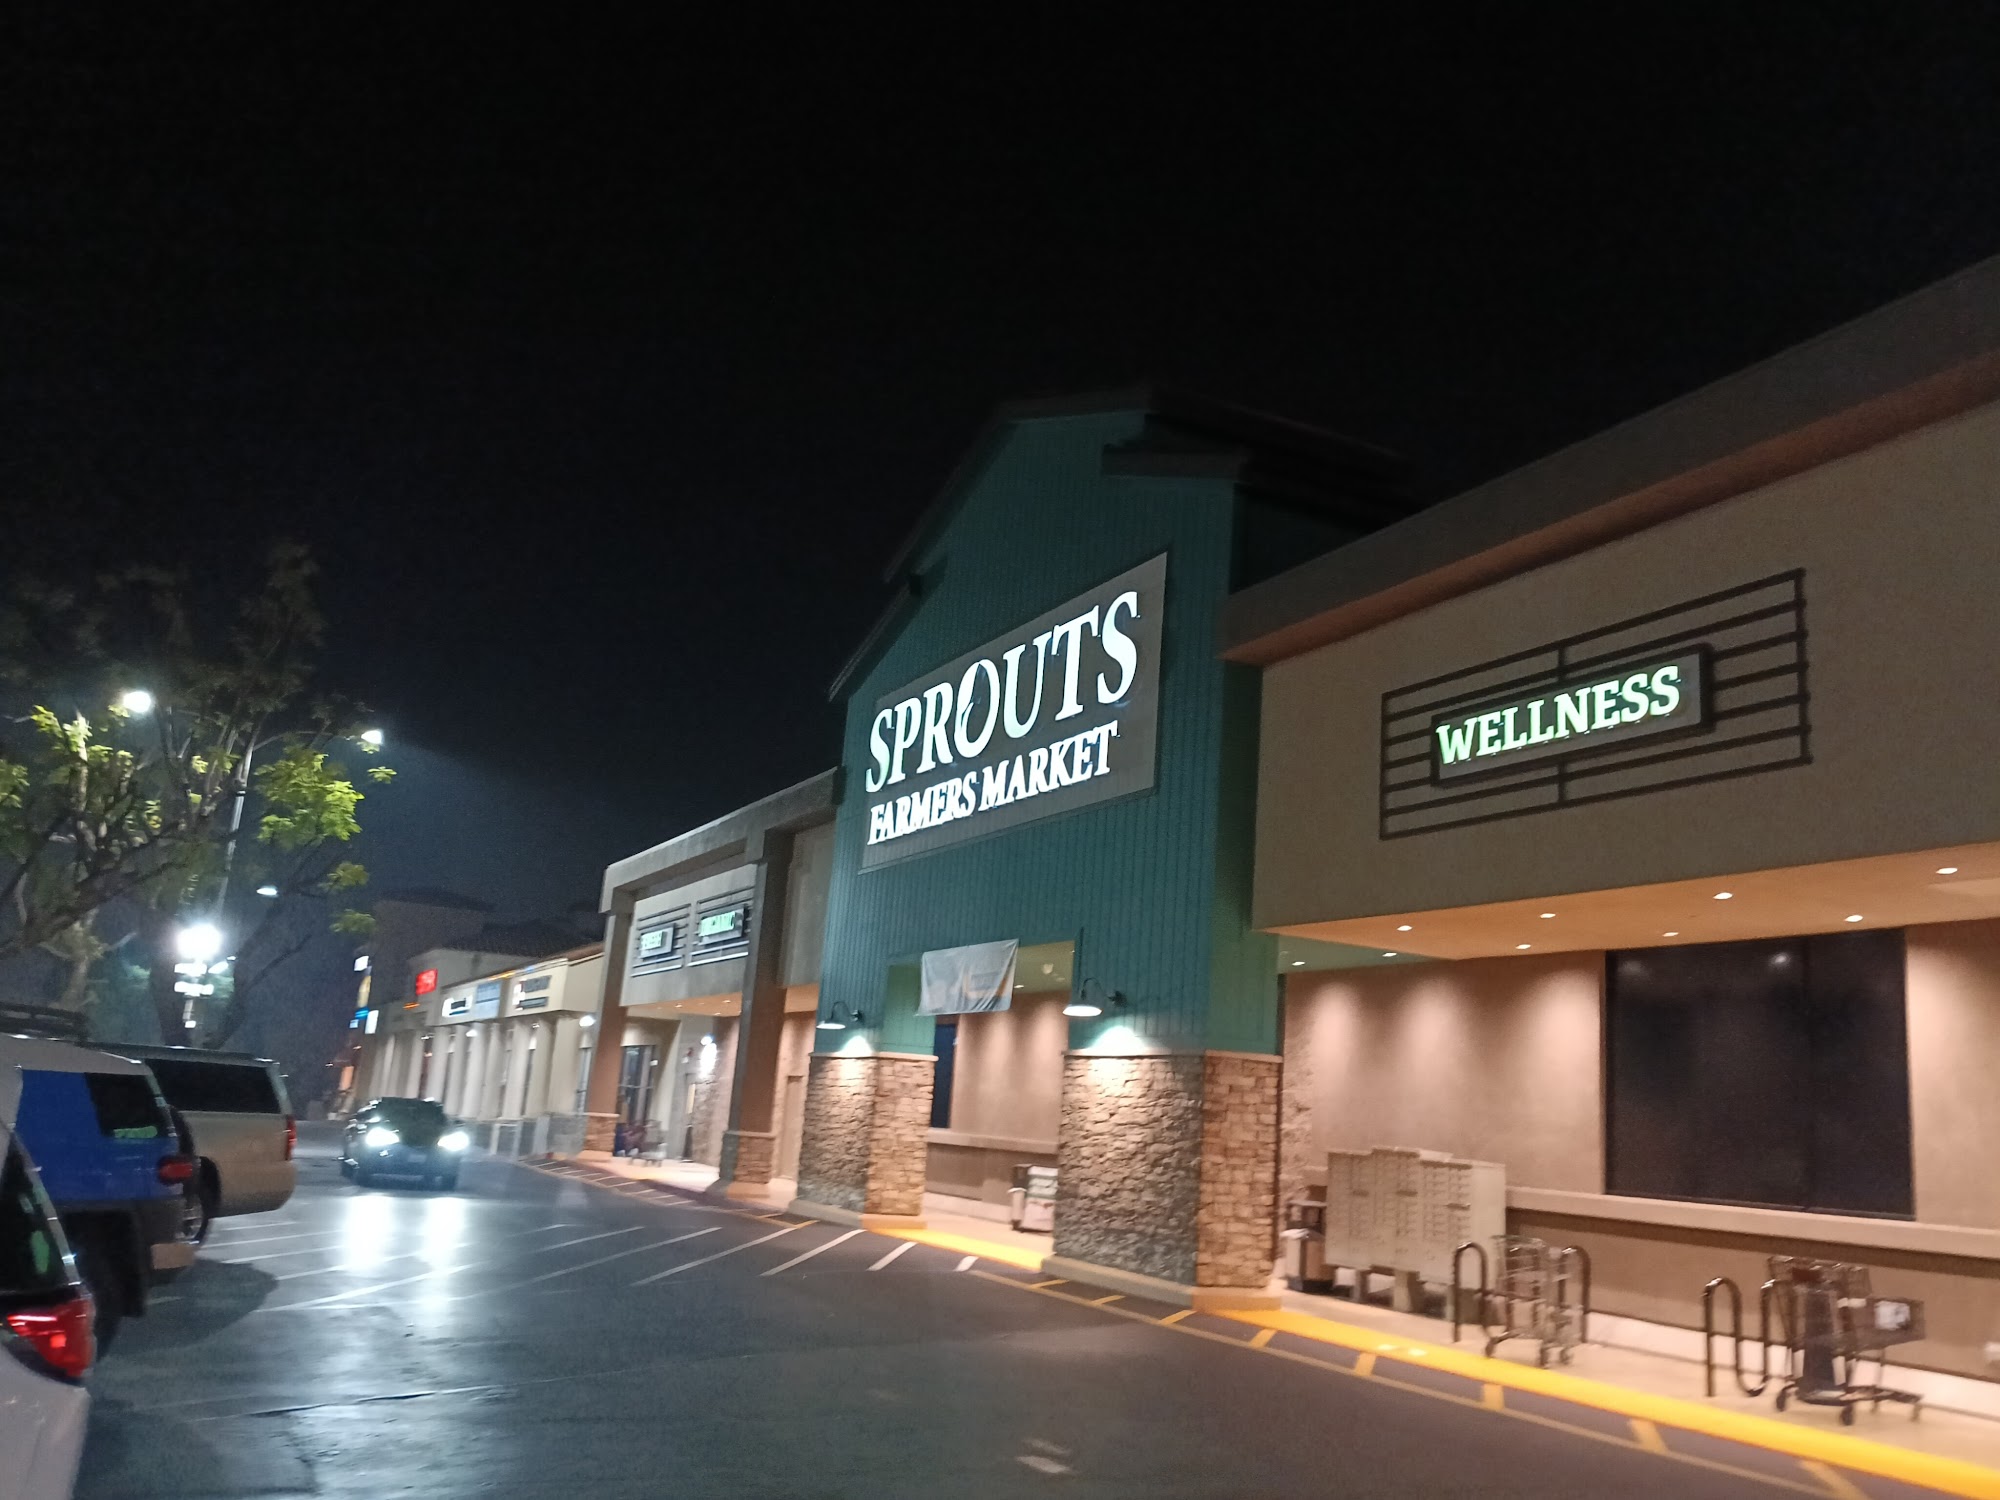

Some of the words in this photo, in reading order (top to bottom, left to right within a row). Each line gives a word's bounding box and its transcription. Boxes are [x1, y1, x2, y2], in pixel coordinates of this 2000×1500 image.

[866, 591, 1137, 792] SPROUTS
[1436, 665, 1680, 765] WELLNESS
[867, 771, 977, 845] FARMERS
[978, 720, 1119, 811] MARKET
